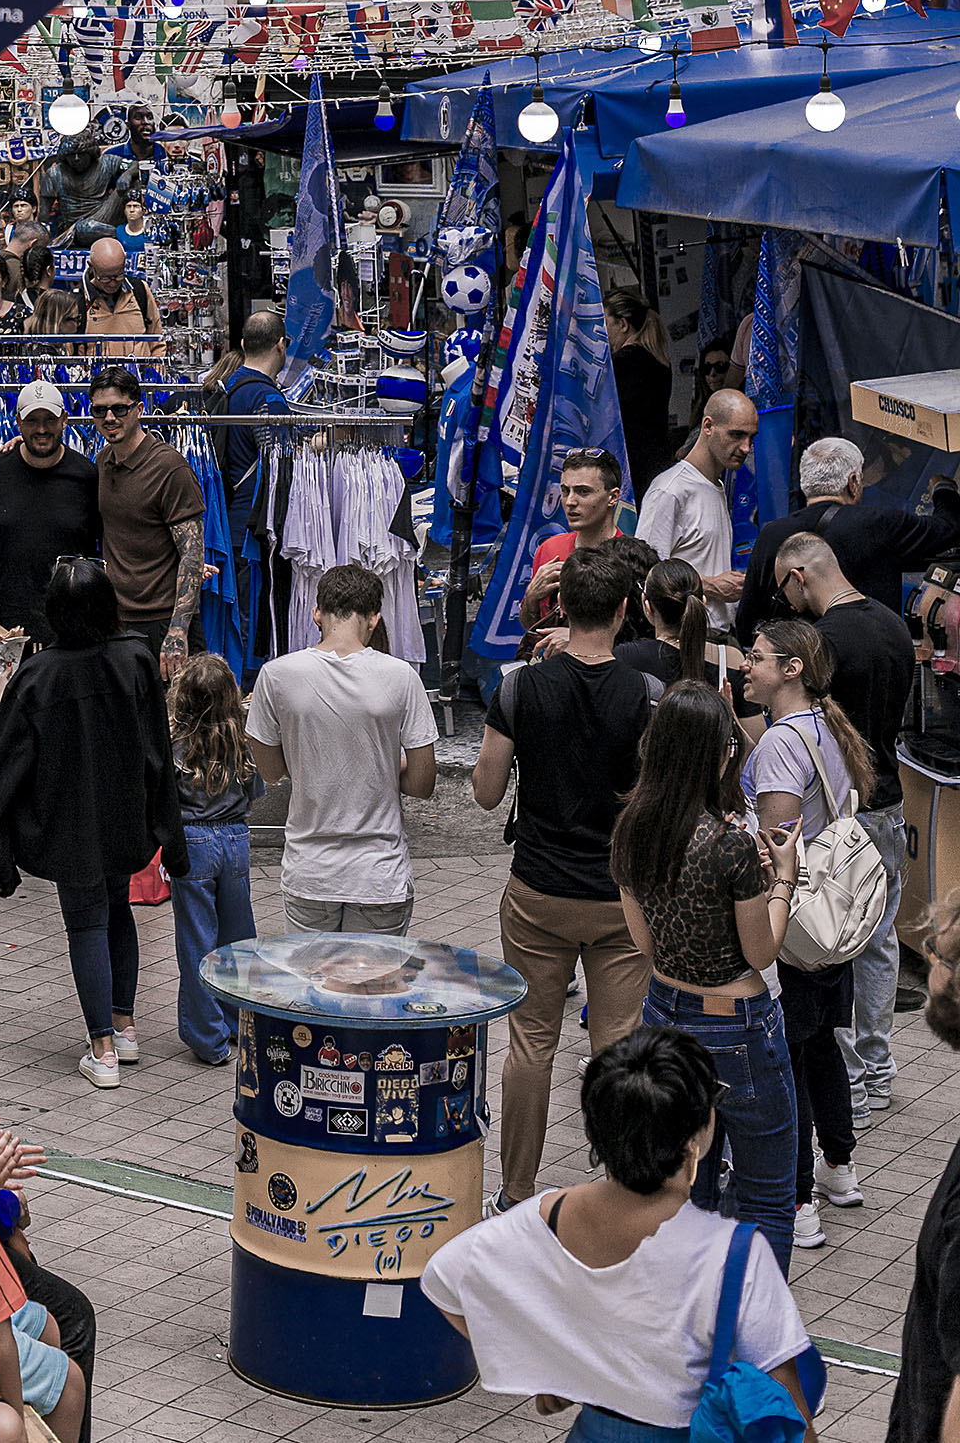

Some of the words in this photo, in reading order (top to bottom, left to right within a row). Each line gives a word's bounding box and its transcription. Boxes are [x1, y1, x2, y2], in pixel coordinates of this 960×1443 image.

[752, 321, 778, 354] DIEGO
[878, 394, 916, 421] CHIOSCO
[375, 1061, 413, 1071] FRACIDI
[377, 1078, 420, 1089] DIEGO
[382, 1089, 417, 1100] VIVE
[326, 1221, 435, 1258] DIEGO
